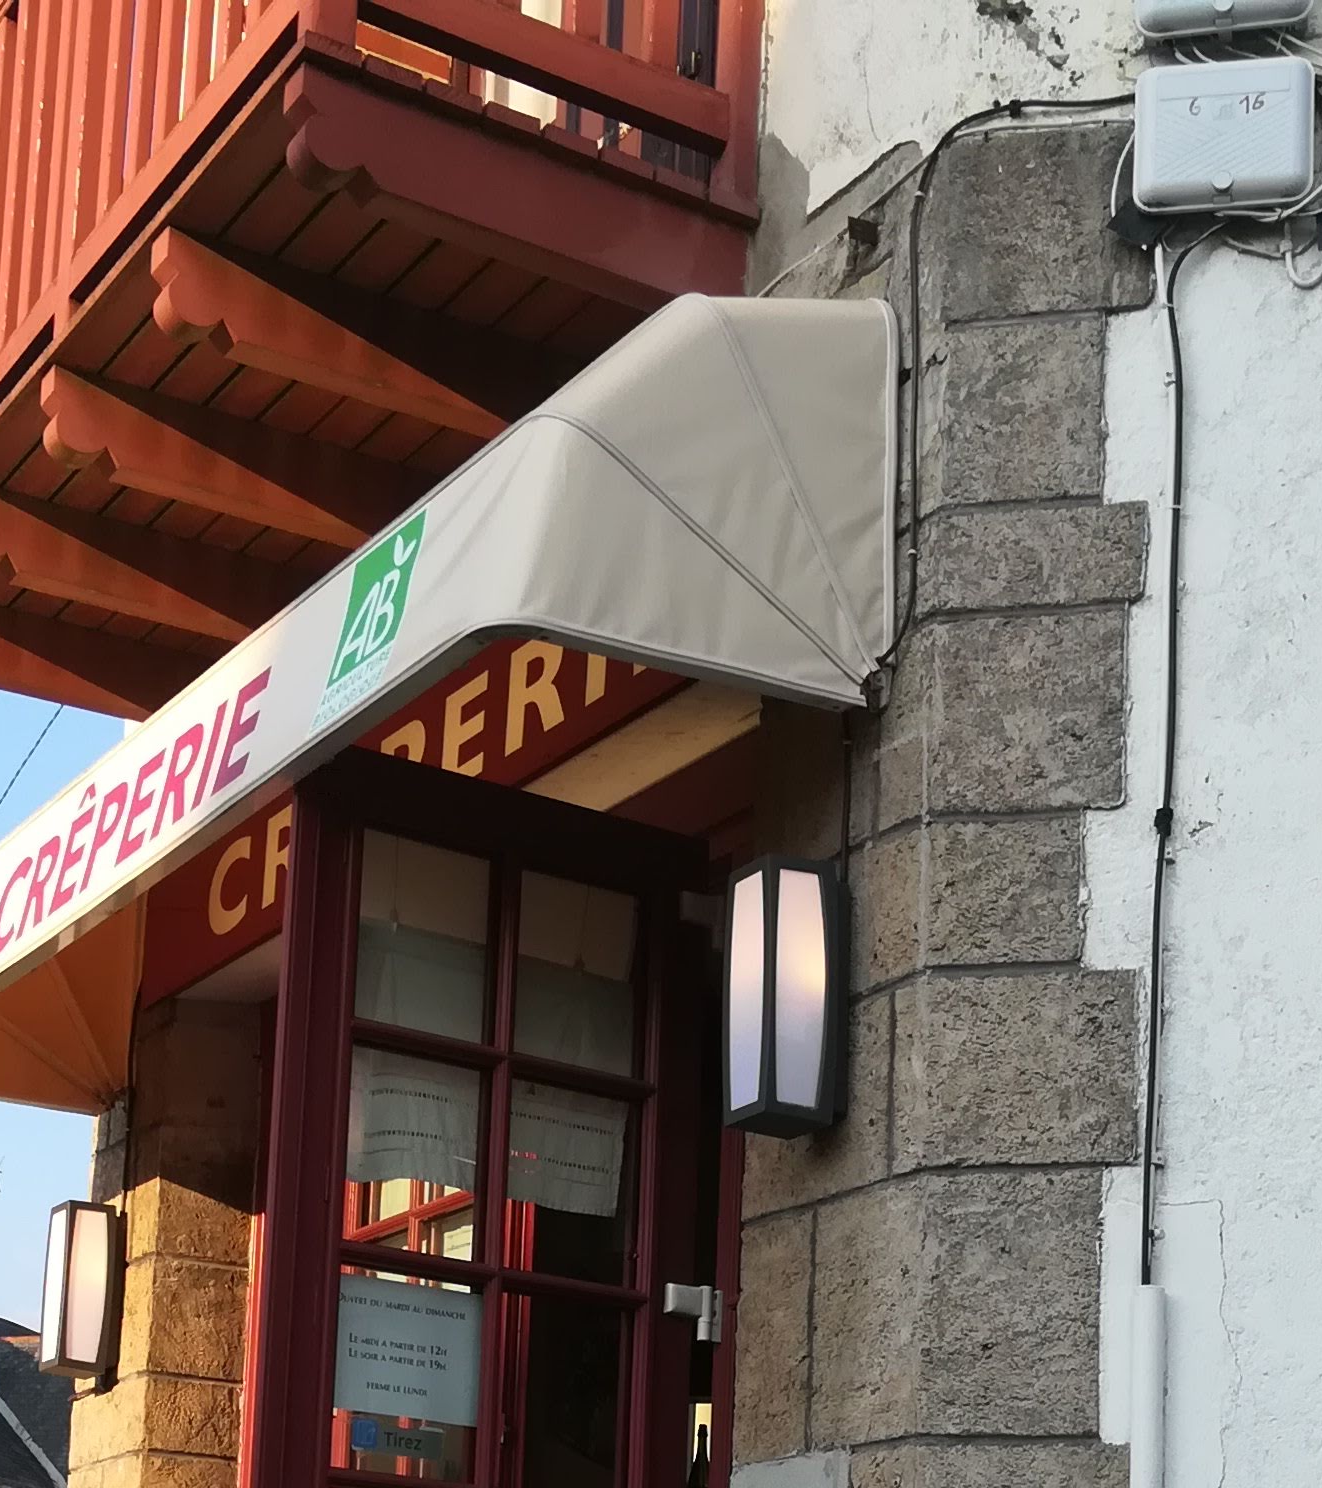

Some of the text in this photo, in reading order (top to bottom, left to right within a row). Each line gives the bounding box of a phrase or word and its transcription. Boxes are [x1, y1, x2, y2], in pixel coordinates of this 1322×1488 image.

[1239, 91, 1266, 114] 16
[332, 569, 401, 681] AB
[384, 1431, 422, 1451] Tirez
